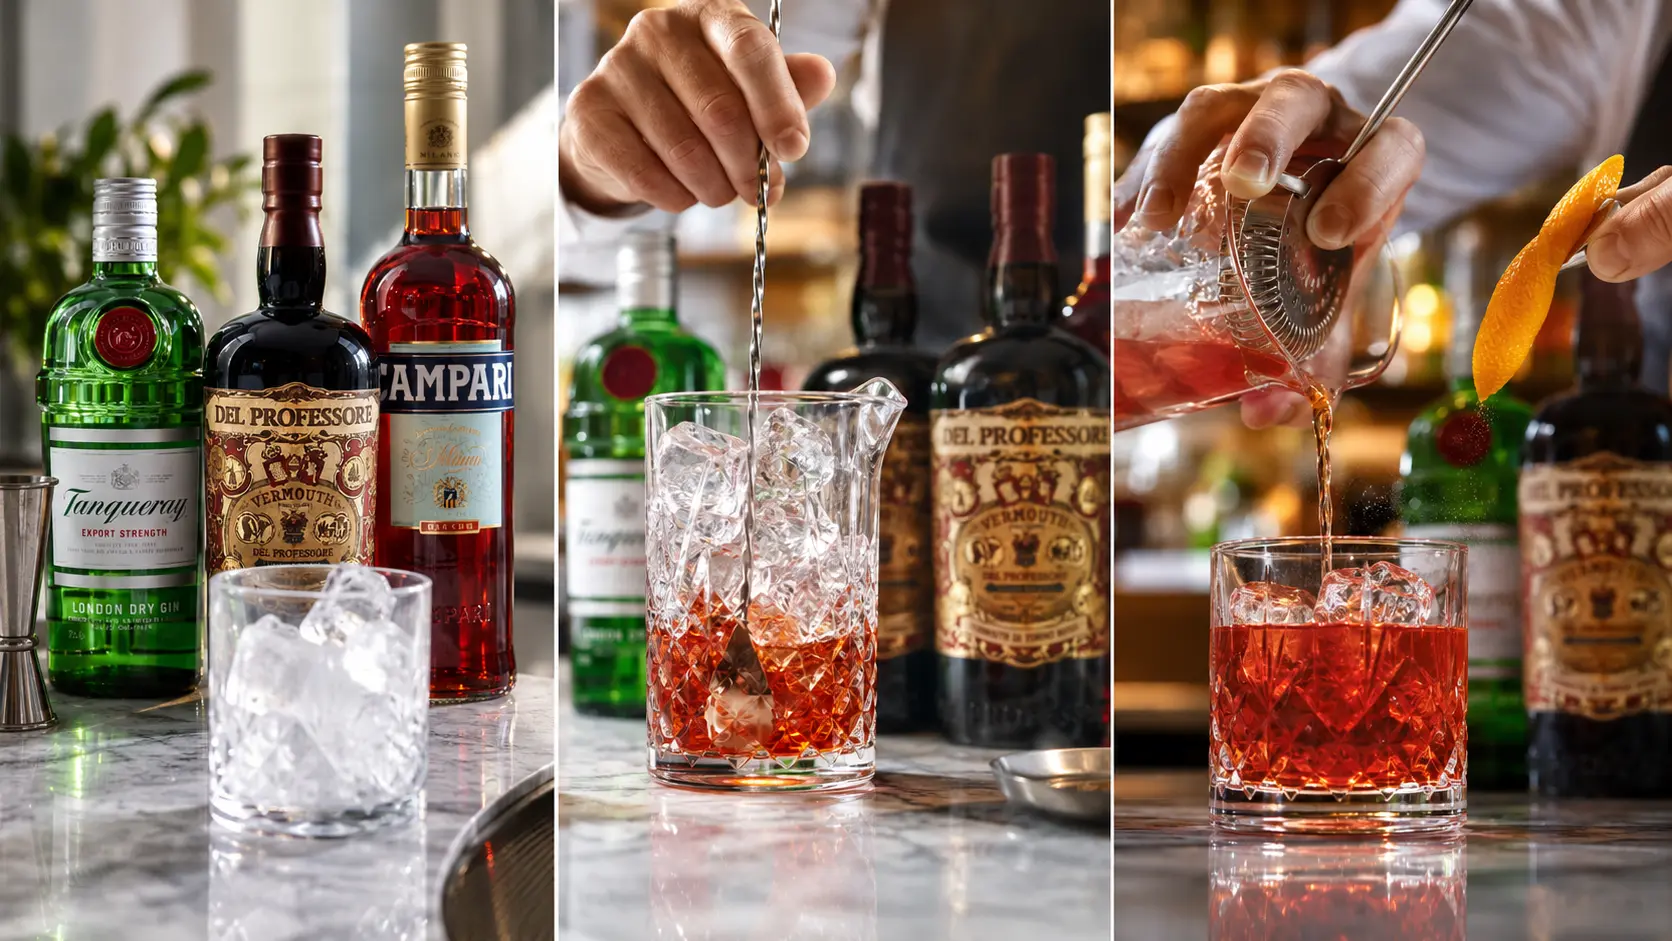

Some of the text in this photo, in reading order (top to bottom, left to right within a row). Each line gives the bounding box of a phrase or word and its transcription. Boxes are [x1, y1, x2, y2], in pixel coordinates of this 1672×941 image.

[215, 405, 373, 428] DEL PROFESSORE
[944, 425, 1107, 446] DEL PROFESSORE
[63, 488, 188, 525] Tanqueray
[251, 487, 335, 509] VERMOUTH
[981, 508, 1069, 530] VERMOUTH
[81, 529, 168, 538] EXPORT STRENGTH
[253, 547, 270, 557] DEL
[72, 601, 180, 615] LONDON DRY GIN
